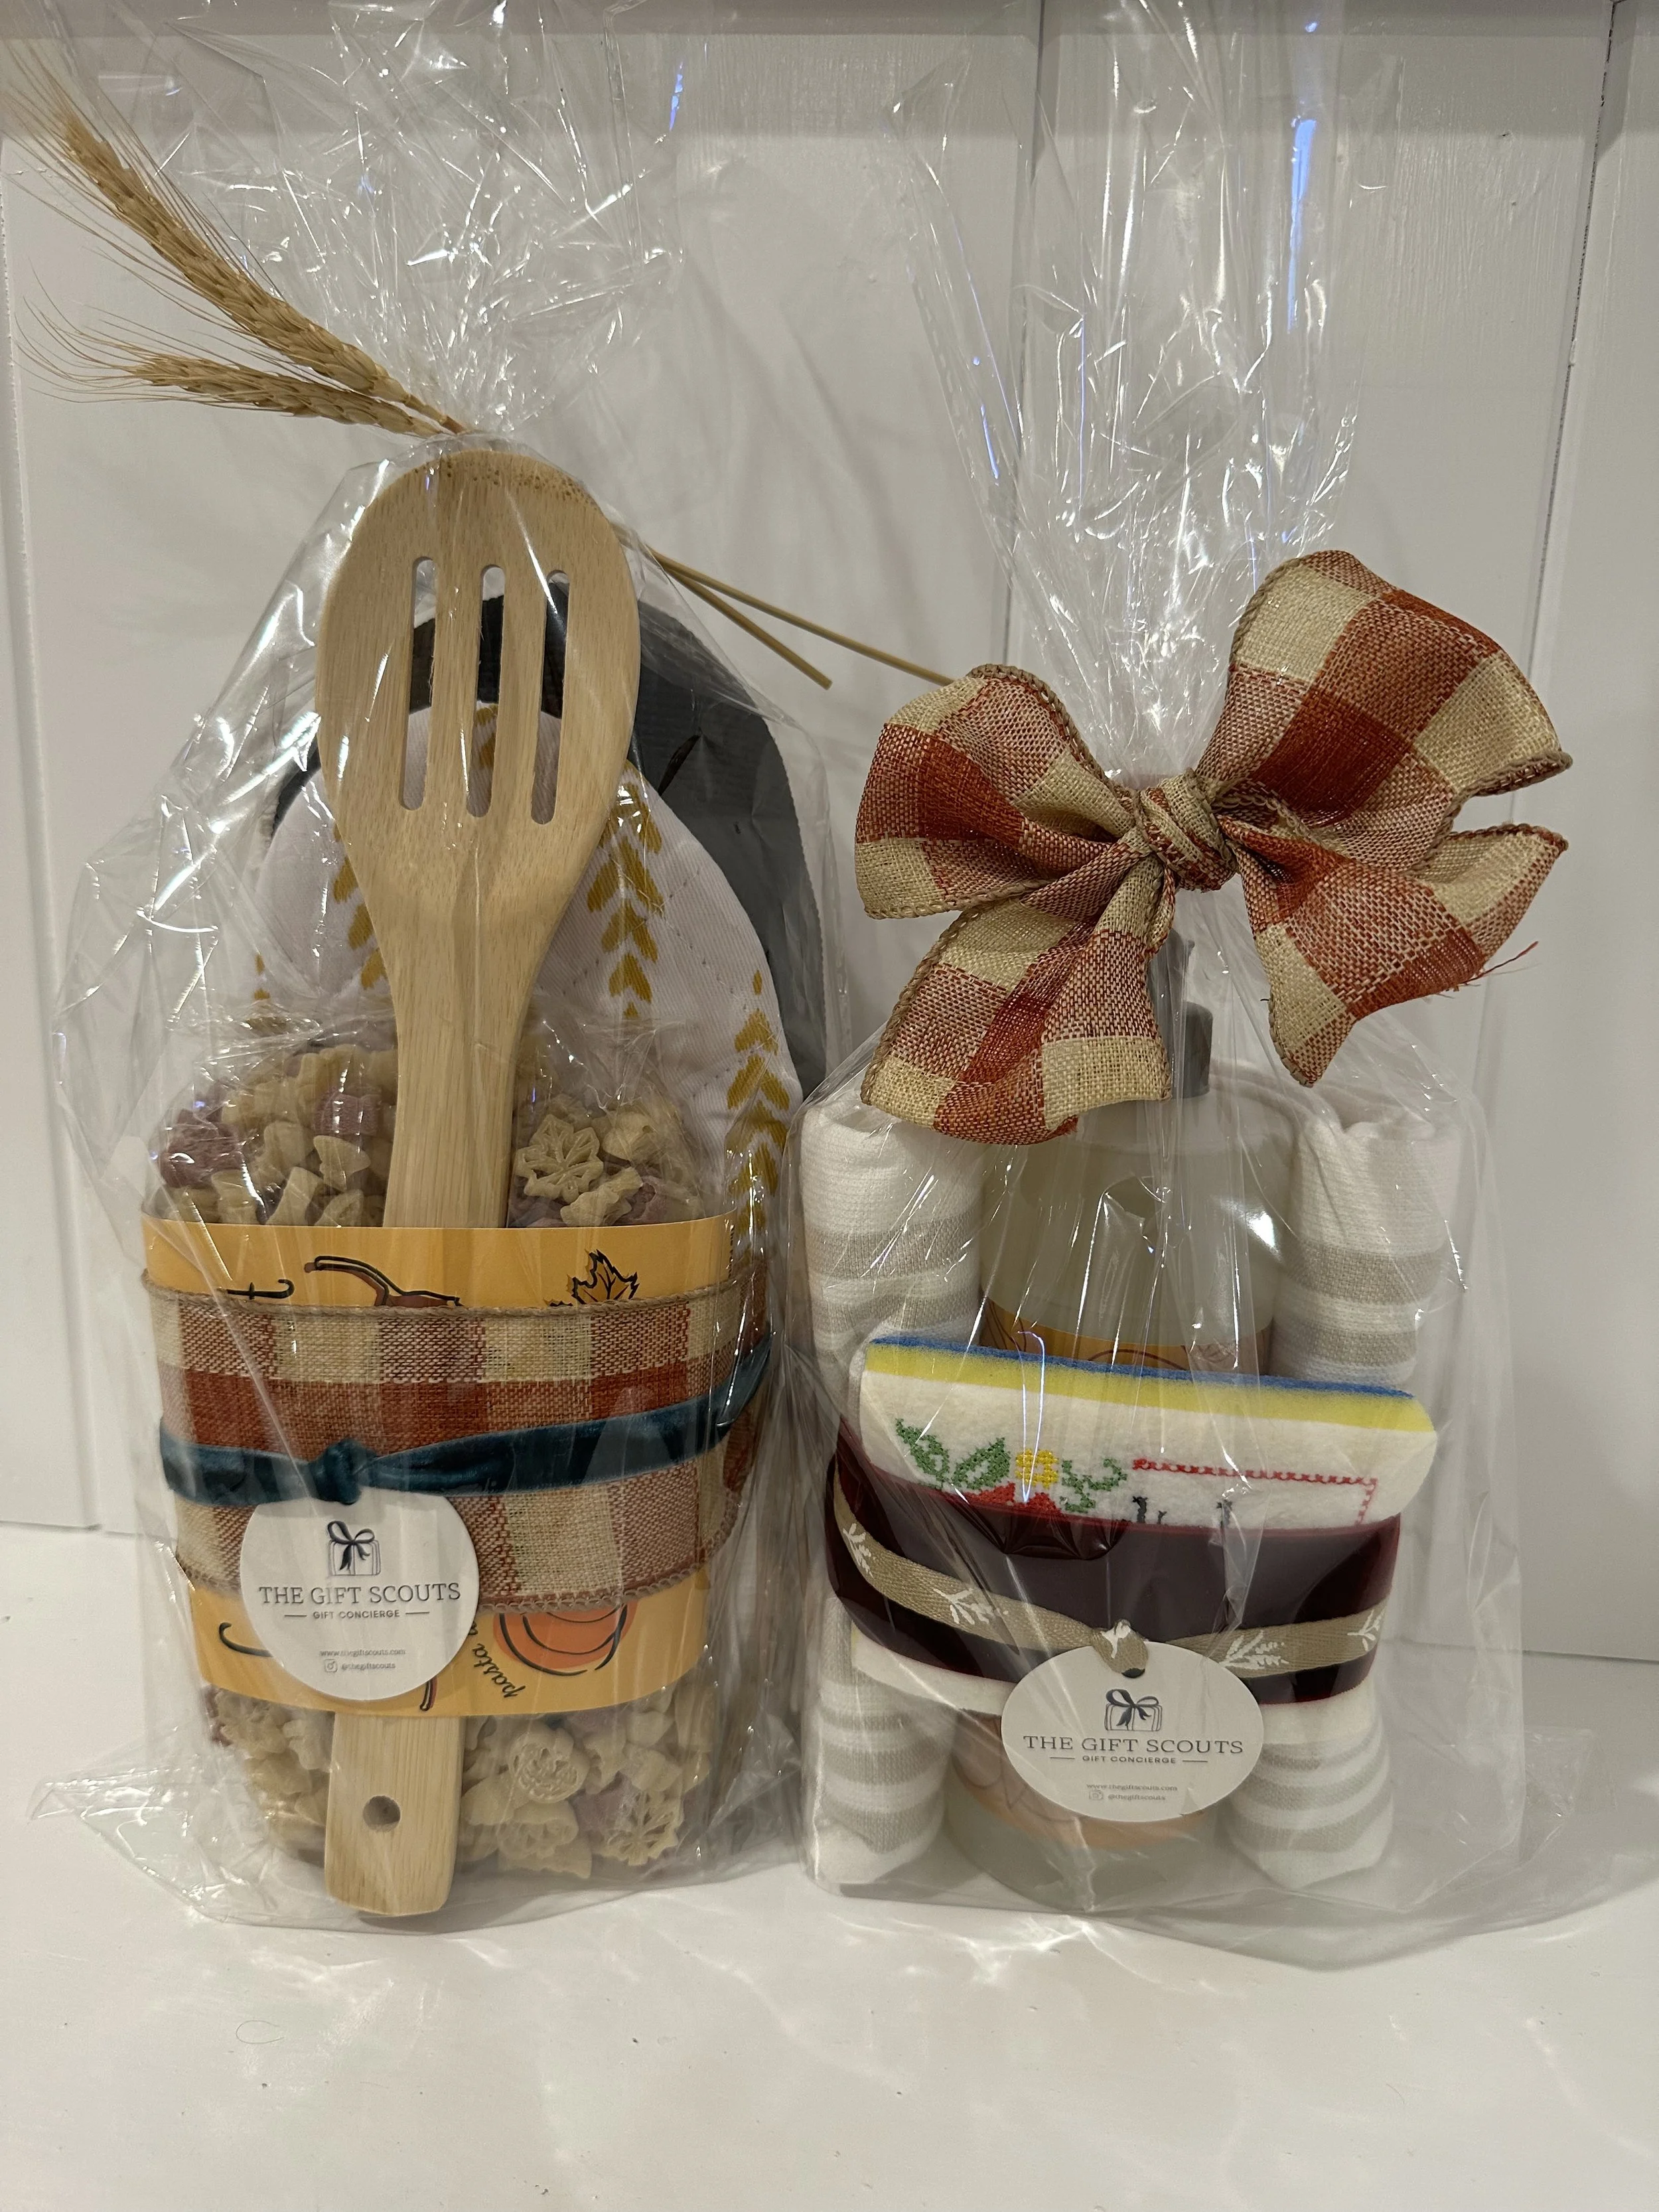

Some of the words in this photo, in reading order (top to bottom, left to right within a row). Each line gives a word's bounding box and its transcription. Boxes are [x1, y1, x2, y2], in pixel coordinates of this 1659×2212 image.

[258, 1587, 304, 1604] THE
[311, 1586, 362, 1605] GIFT
[370, 1582, 461, 1603] SCOUTS
[313, 1611, 333, 1619] GIFT
[339, 1609, 399, 1619] CONCIERGE
[472, 1643, 526, 1698] pasta
[1023, 1735, 1073, 1750] THE
[1082, 1737, 1138, 1752] GIFT
[1147, 1739, 1243, 1754] SCOUTS
